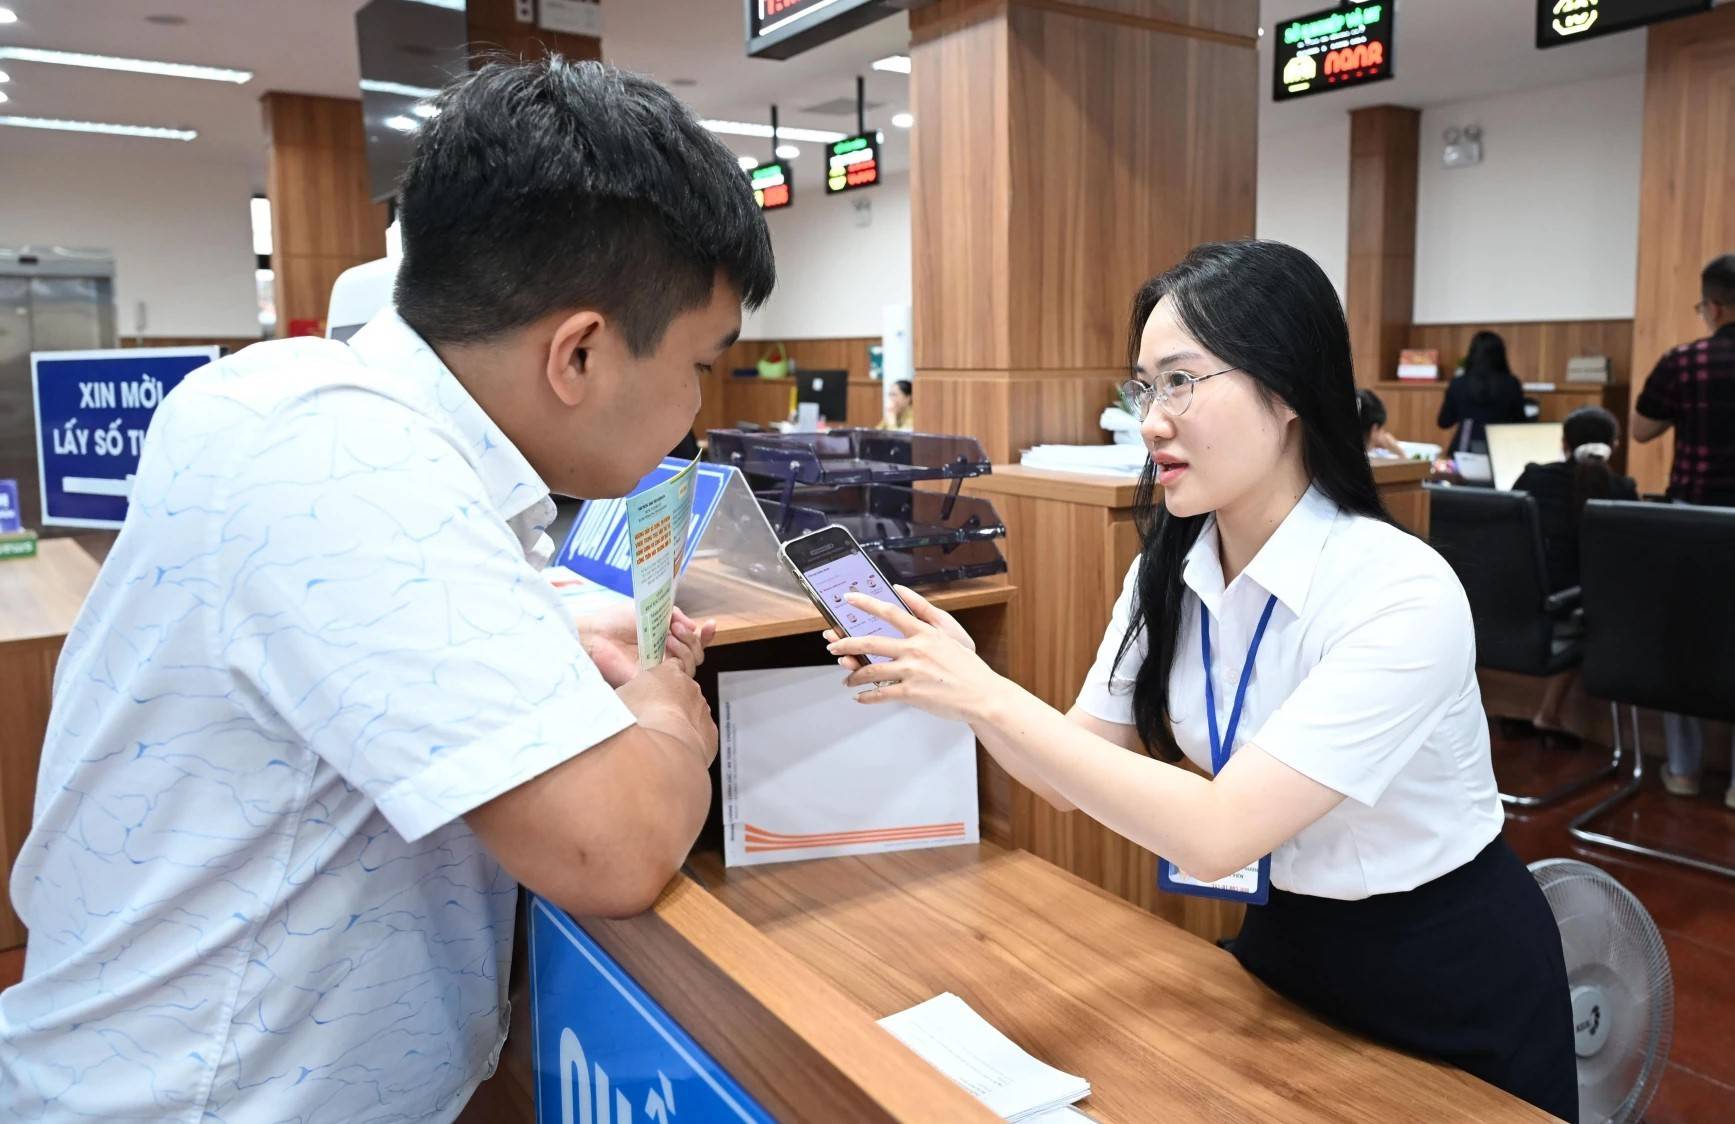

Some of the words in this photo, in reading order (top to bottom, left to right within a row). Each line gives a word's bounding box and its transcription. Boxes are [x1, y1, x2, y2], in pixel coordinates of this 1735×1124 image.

[79, 381, 116, 409] XIN
[120, 373, 164, 409] MỜI
[53, 417, 89, 456] LẤY
[93, 417, 124, 456] SỐ
